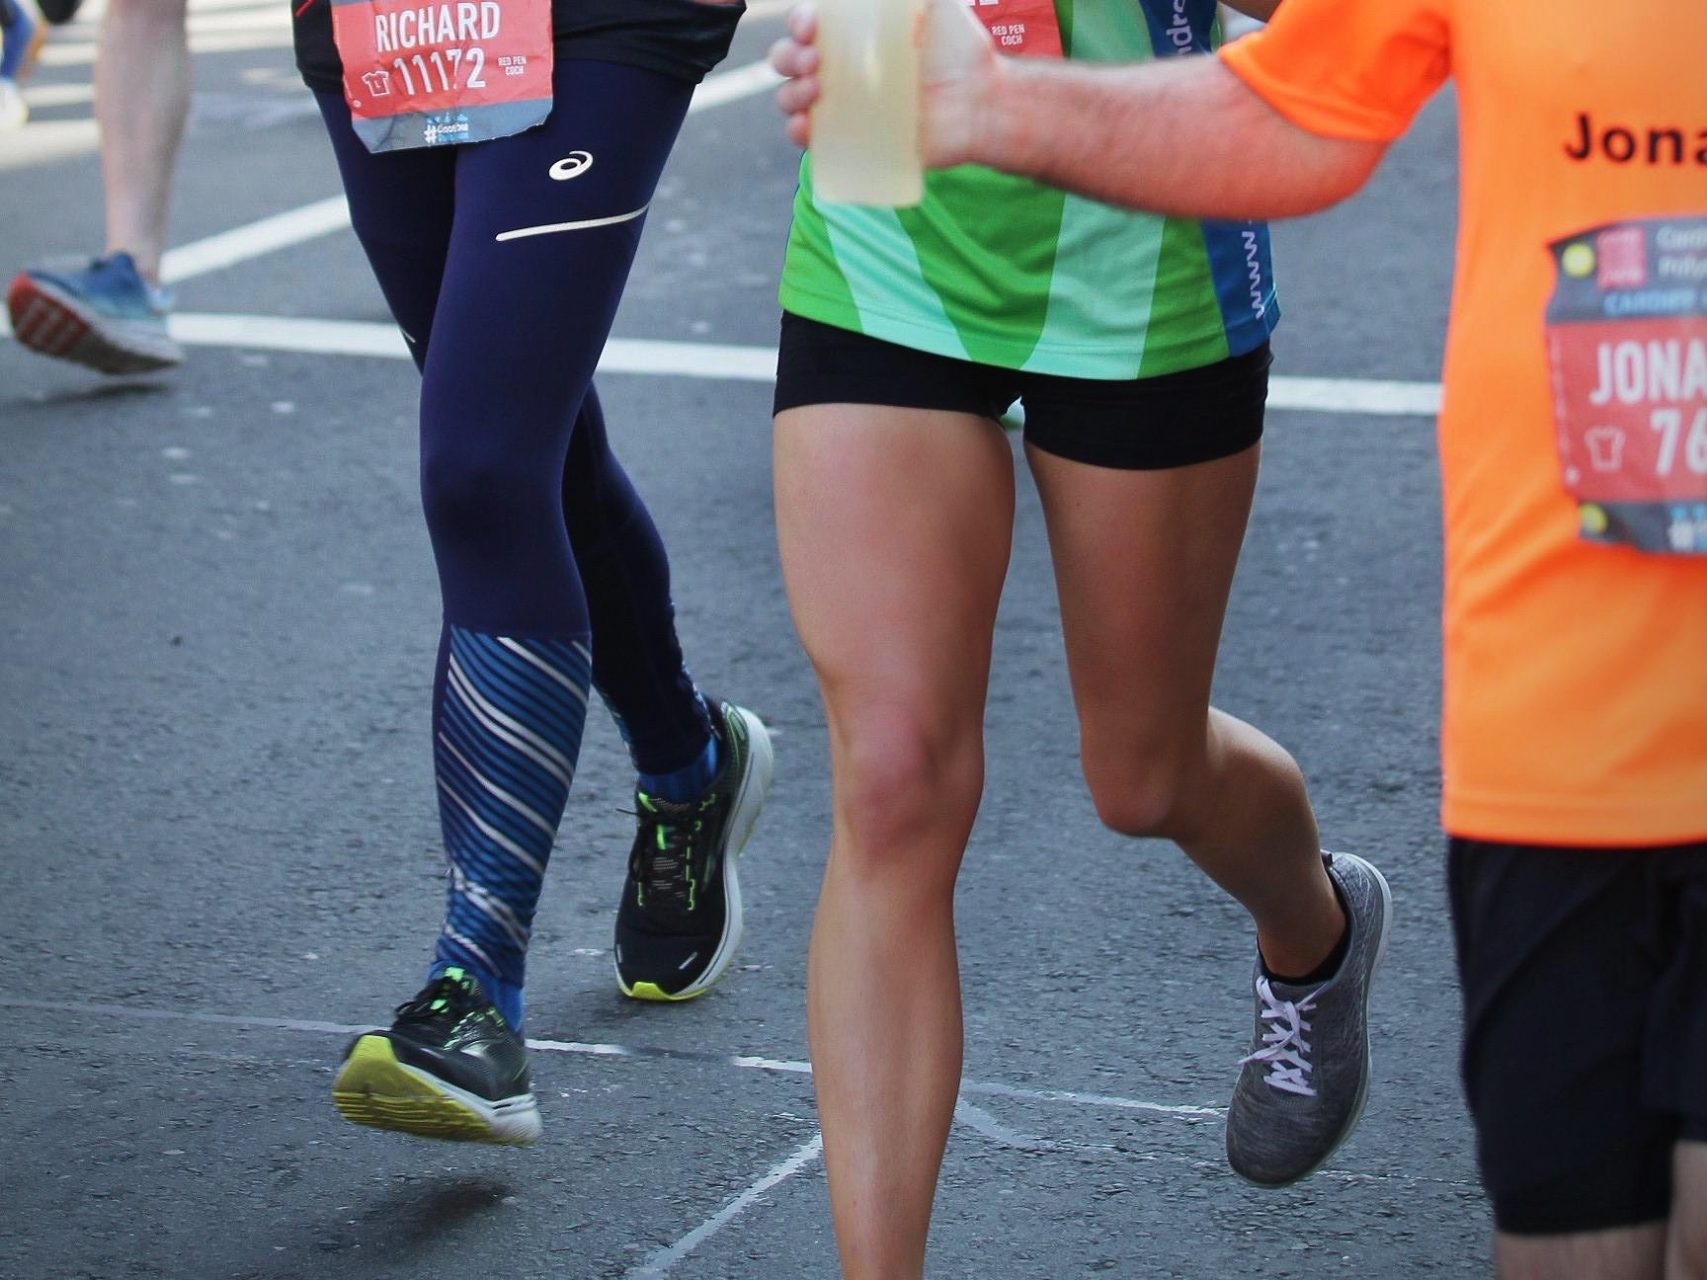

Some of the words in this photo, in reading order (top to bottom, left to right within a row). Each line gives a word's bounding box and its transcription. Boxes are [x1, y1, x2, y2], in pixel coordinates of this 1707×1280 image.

[375, 1, 500, 53] RICHARD
[992, 24, 1007, 36] RED
[1009, 23, 1025, 35] PEN
[394, 47, 487, 96] 11172
